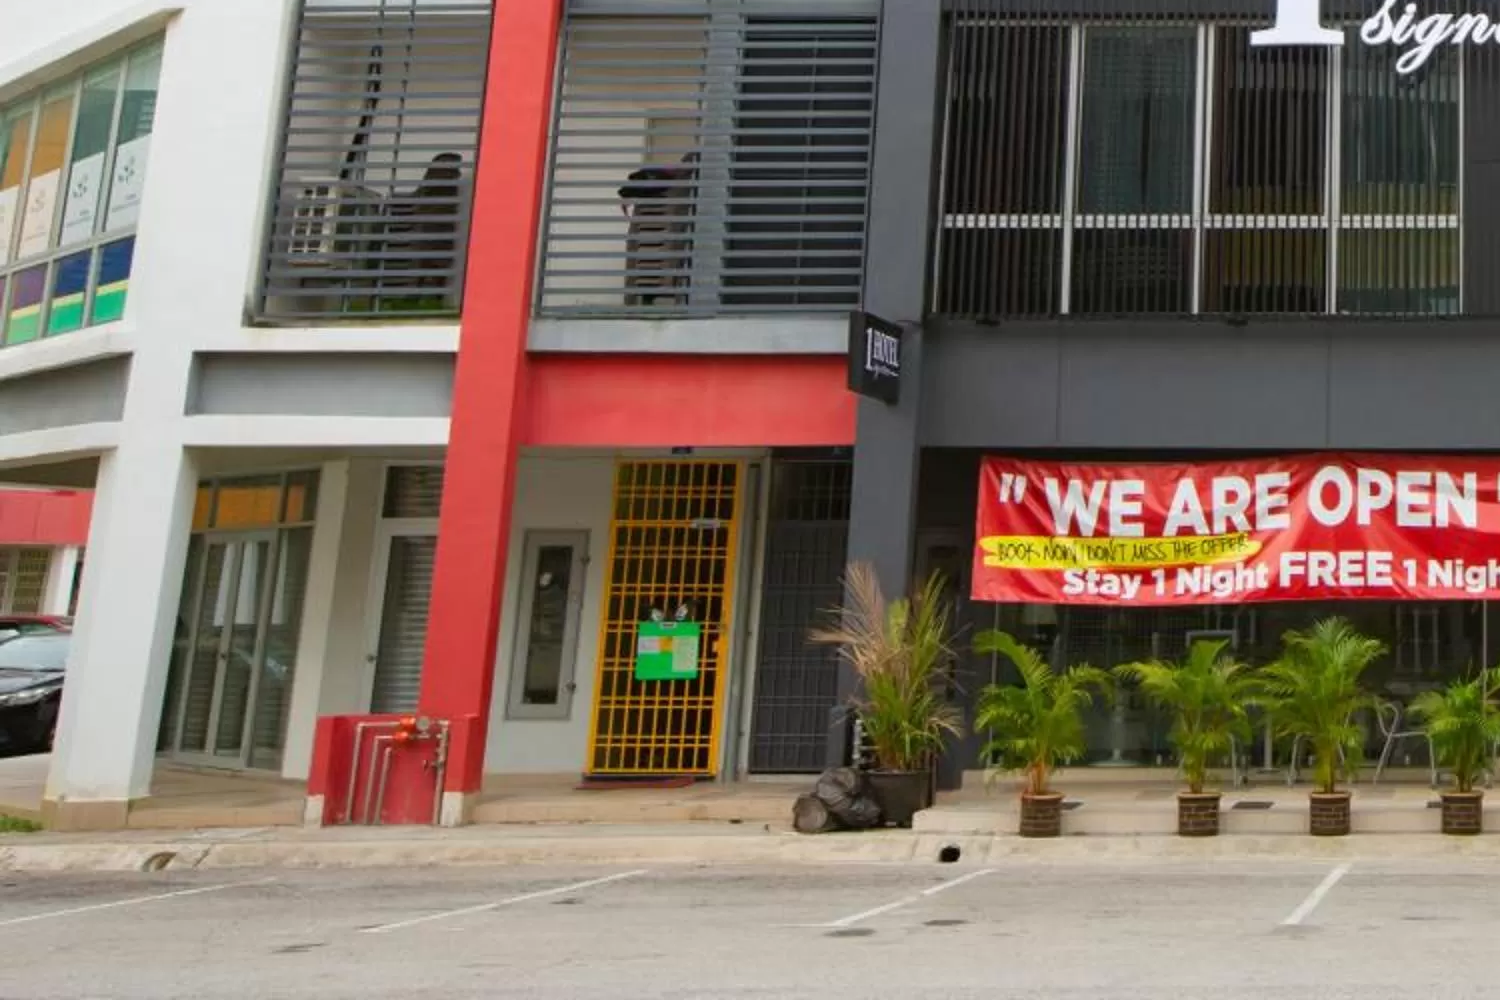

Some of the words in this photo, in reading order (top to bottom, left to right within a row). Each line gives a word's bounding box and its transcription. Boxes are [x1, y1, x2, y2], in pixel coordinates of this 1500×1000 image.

[1162, 471, 1292, 537] ARE
[997, 543, 1041, 563] BOOK
[1131, 542, 1168, 562] MISS
[1168, 540, 1198, 559] THE
[1062, 568, 1143, 600] Stay
[1151, 567, 1165, 596] 1
[1175, 561, 1270, 599] Night
[1279, 551, 1393, 588] FREE
[1402, 560, 1417, 588] 1
